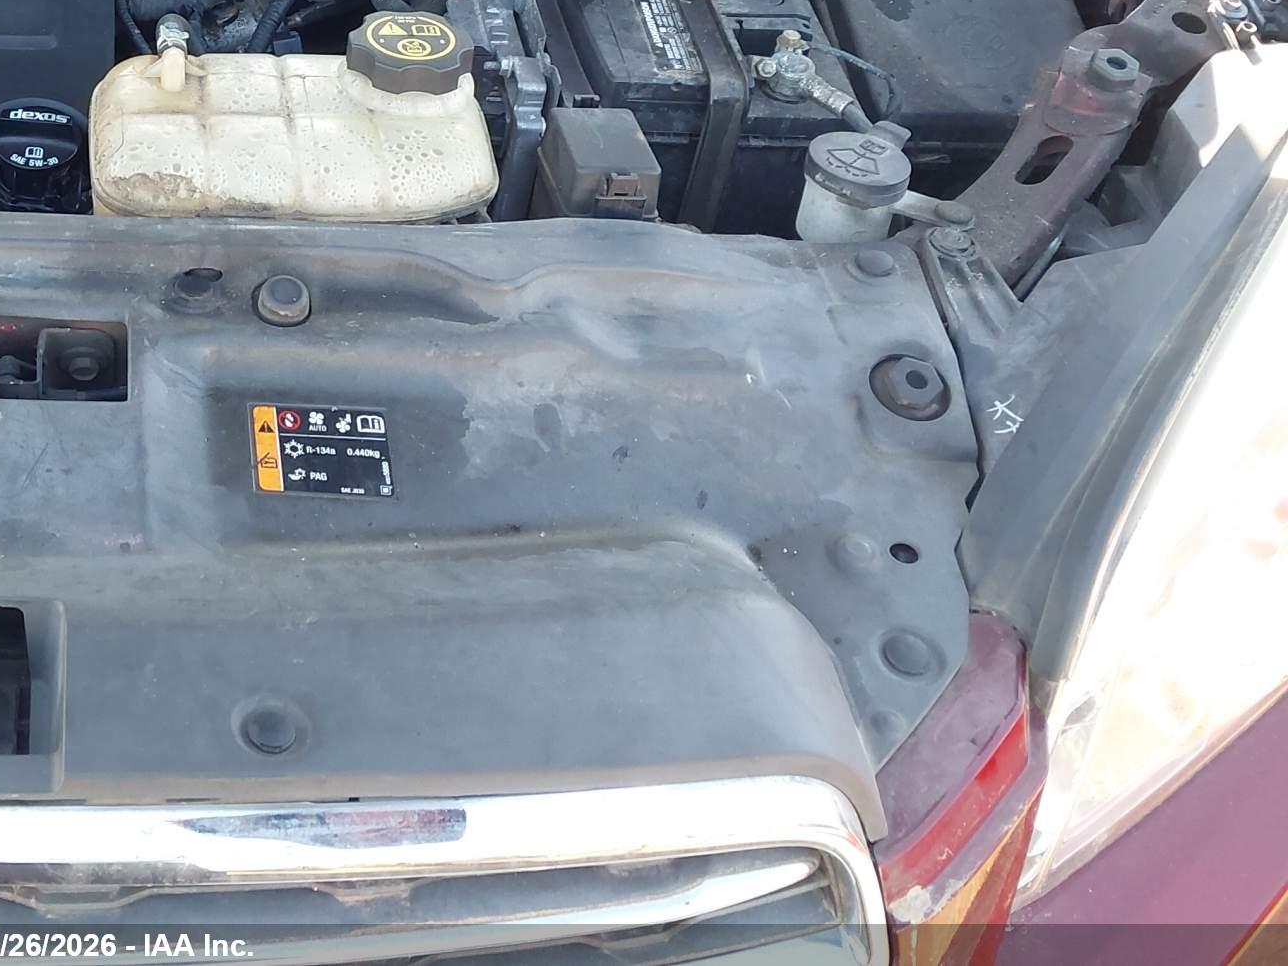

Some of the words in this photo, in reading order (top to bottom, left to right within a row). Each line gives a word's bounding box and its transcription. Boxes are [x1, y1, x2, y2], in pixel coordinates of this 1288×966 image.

[9, 108, 71, 124] dexos
[10, 153, 27, 165] SAE
[28, 156, 59, 167] 5W-30
[308, 424, 327, 432] AUTO
[306, 445, 337, 455] R-134a
[347, 447, 381, 459] 0.440kg
[309, 471, 328, 481] PAG
